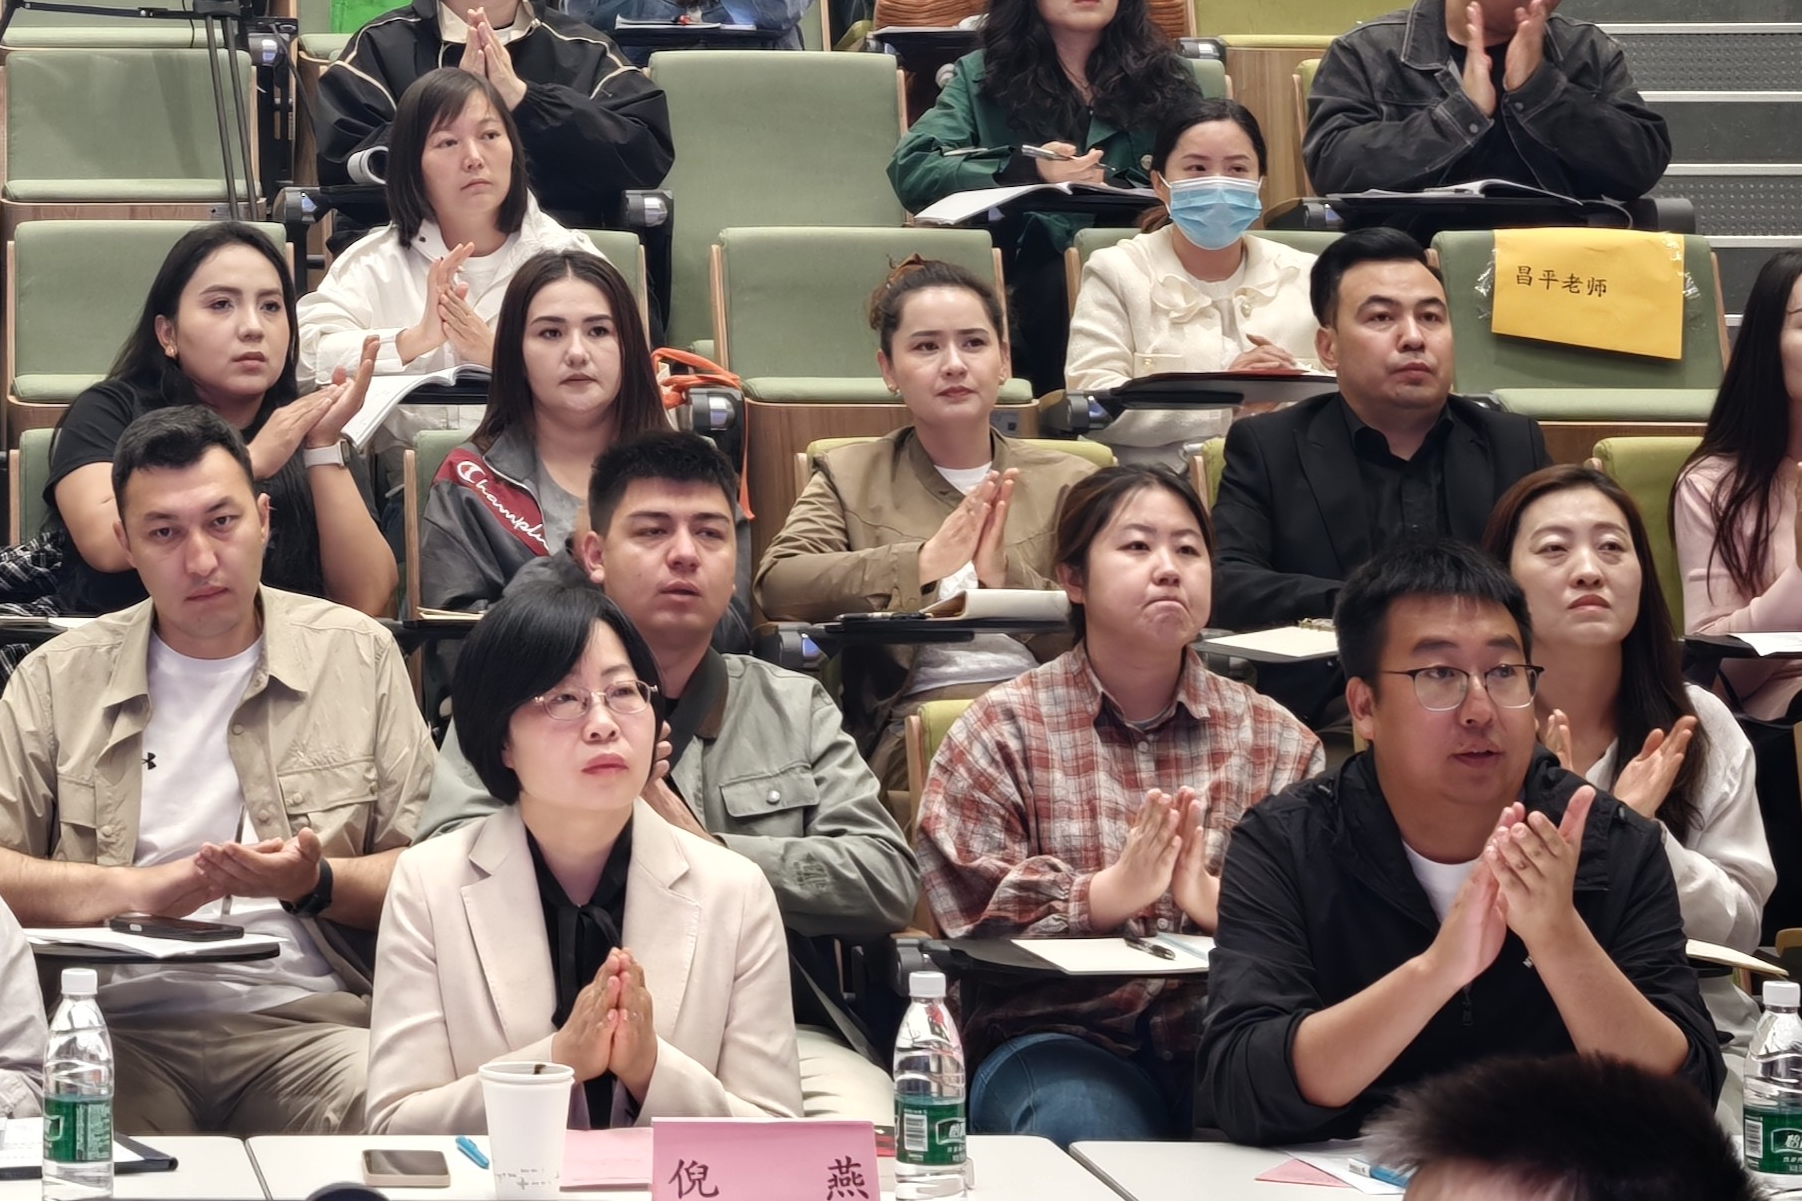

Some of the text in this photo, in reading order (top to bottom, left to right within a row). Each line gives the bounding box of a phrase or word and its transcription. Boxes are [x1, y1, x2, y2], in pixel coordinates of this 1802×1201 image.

[1516, 265, 1608, 298] 昌平老师
[668, 1155, 870, 1201] 倪燕
